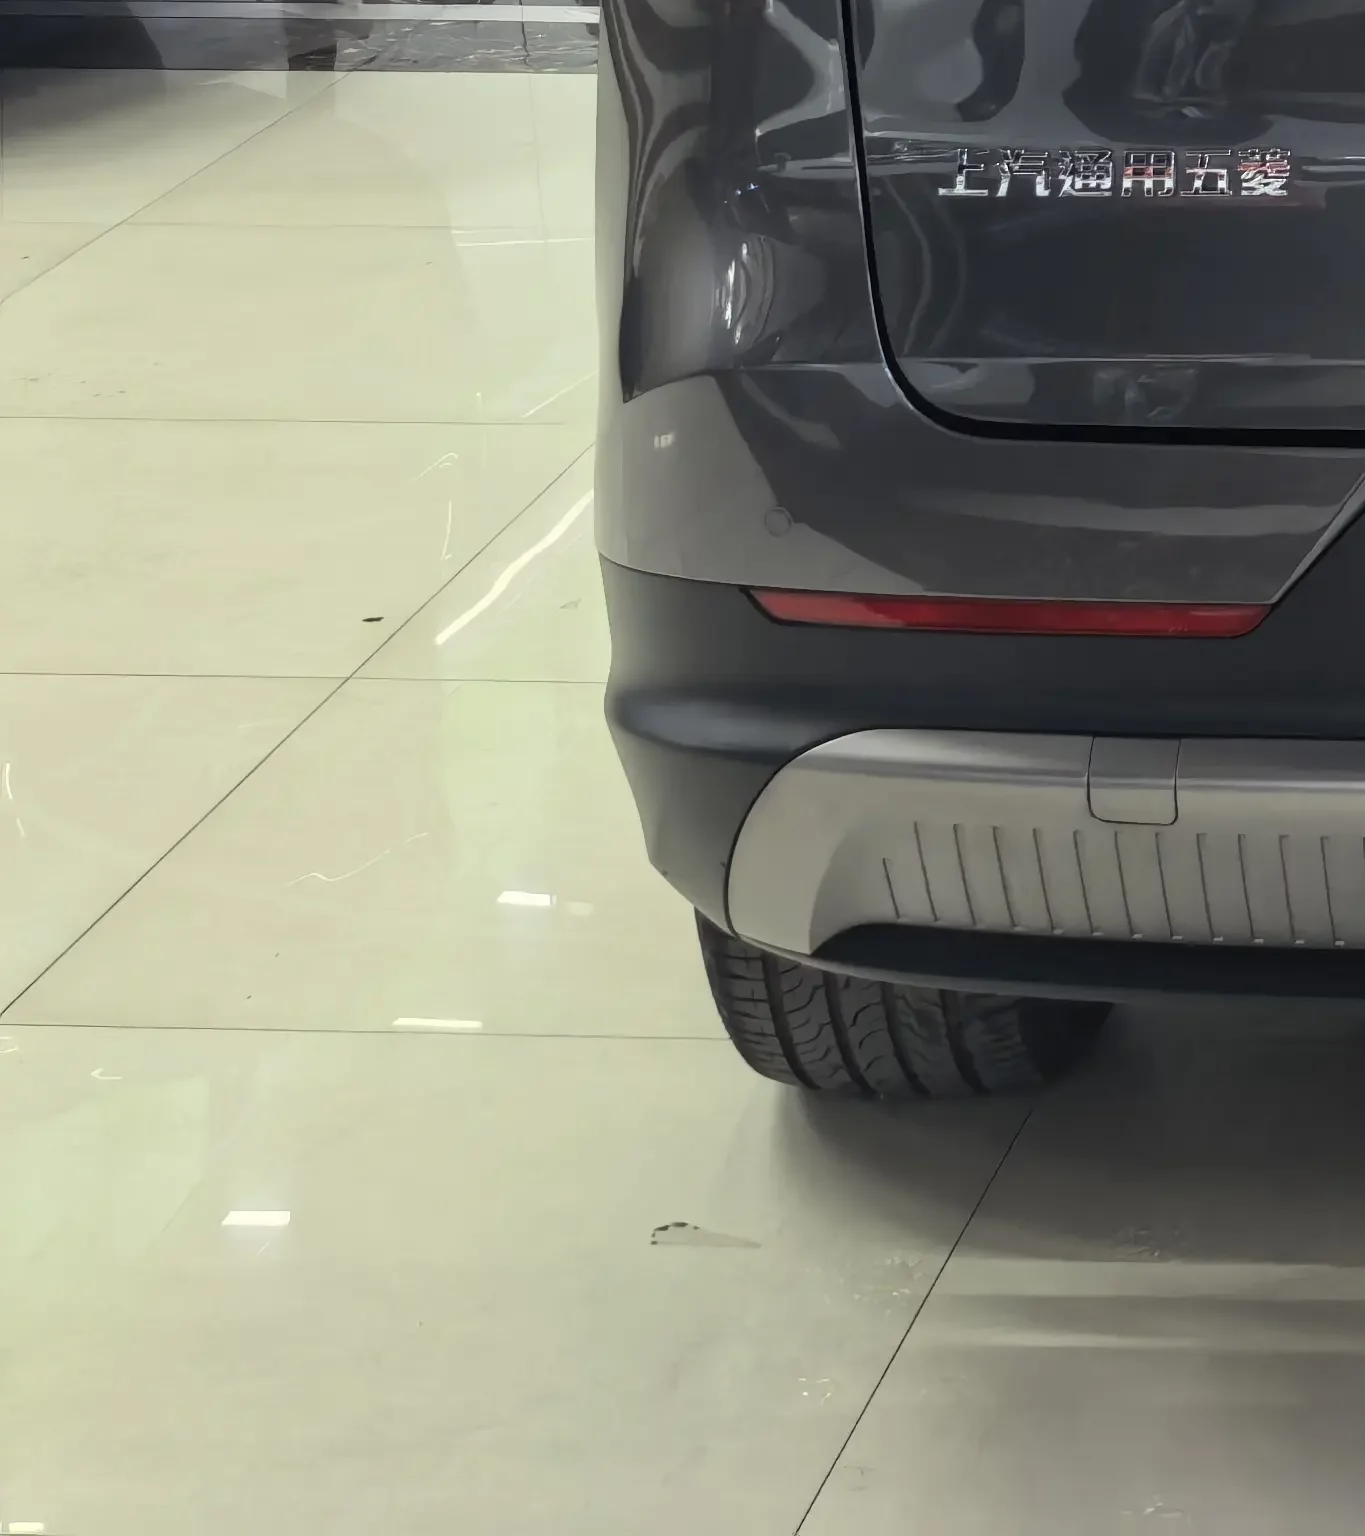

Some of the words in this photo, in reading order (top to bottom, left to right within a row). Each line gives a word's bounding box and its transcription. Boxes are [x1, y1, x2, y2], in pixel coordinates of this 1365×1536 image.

[938, 148, 1290, 197] 上汽通用五菱
